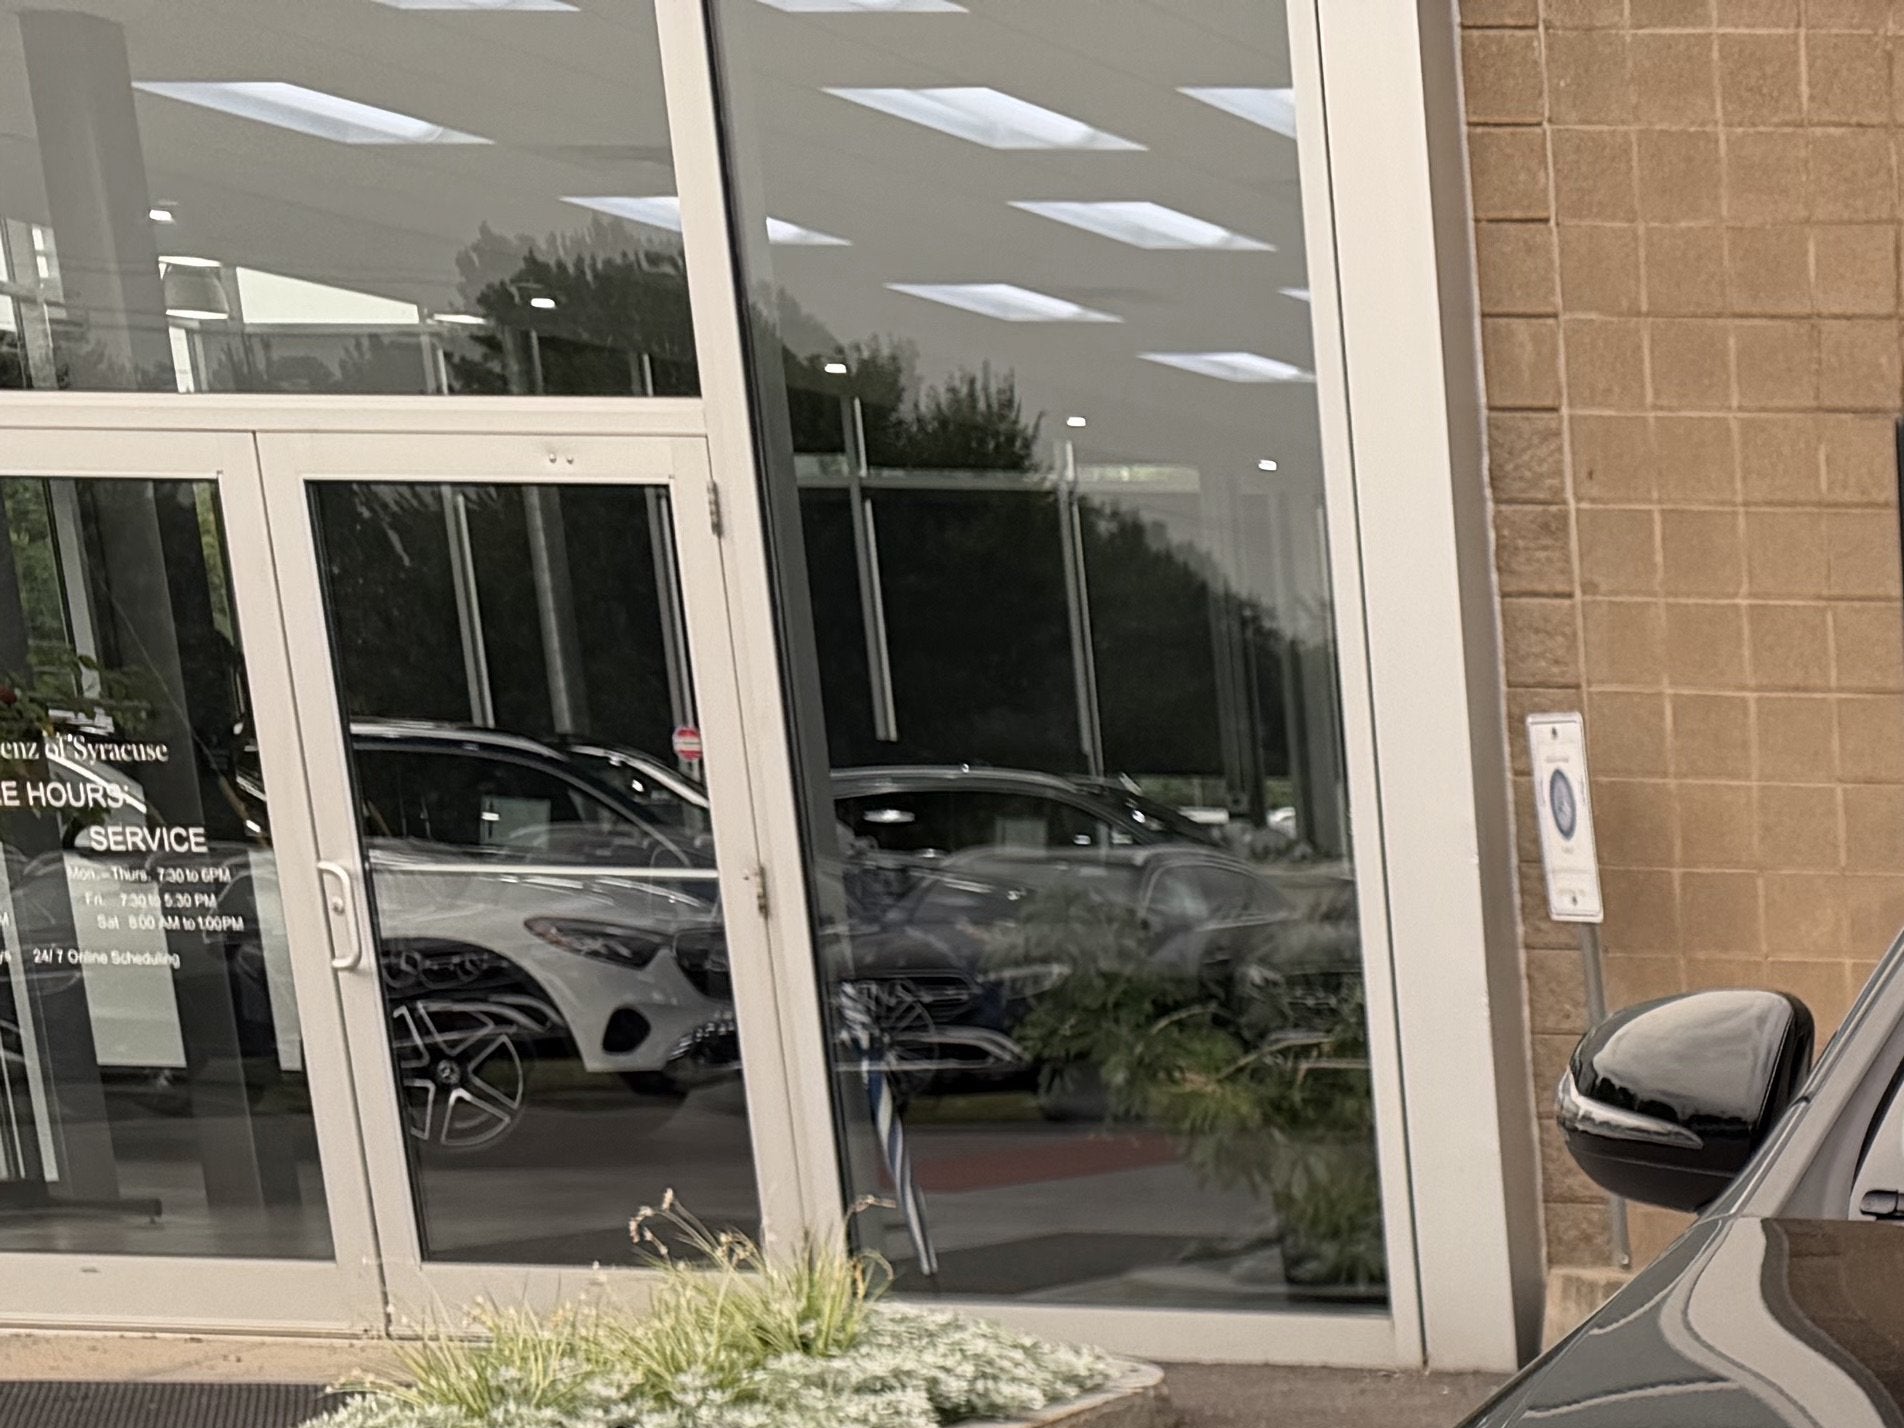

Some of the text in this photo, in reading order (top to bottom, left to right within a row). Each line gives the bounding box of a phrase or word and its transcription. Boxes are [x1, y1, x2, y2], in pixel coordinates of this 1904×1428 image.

[73, 734, 169, 764] Syracuse
[0, 780, 20, 806] E
[90, 825, 208, 853] SERVICE
